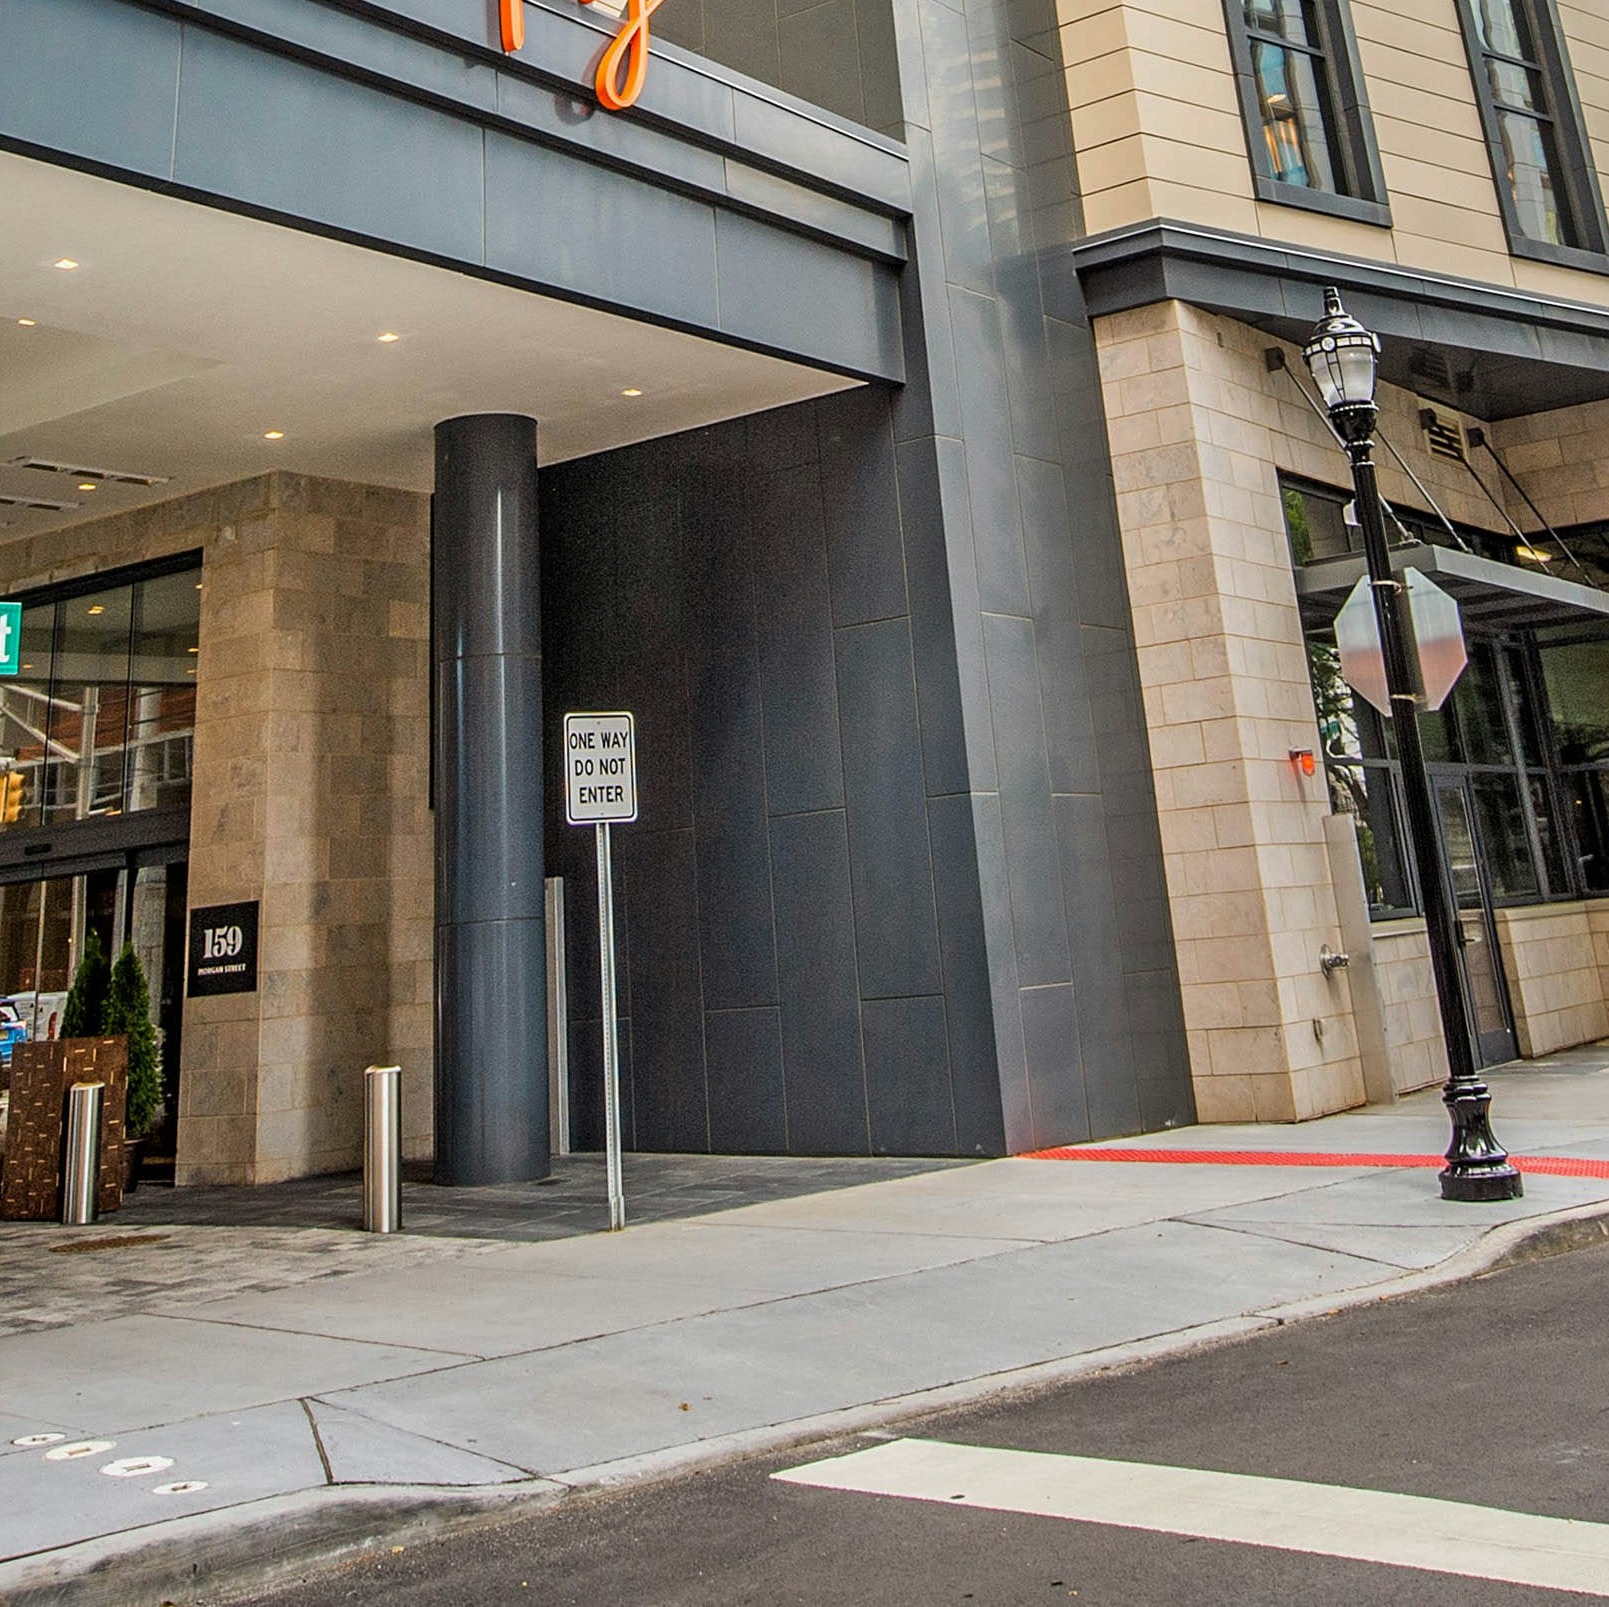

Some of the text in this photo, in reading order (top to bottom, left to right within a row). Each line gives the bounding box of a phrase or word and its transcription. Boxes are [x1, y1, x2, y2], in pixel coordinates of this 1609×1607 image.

[569, 731, 629, 750] ONE WAY
[574, 758, 626, 777] DO NOT
[579, 785, 624, 804] ENTER
[202, 925, 243, 959] 159
